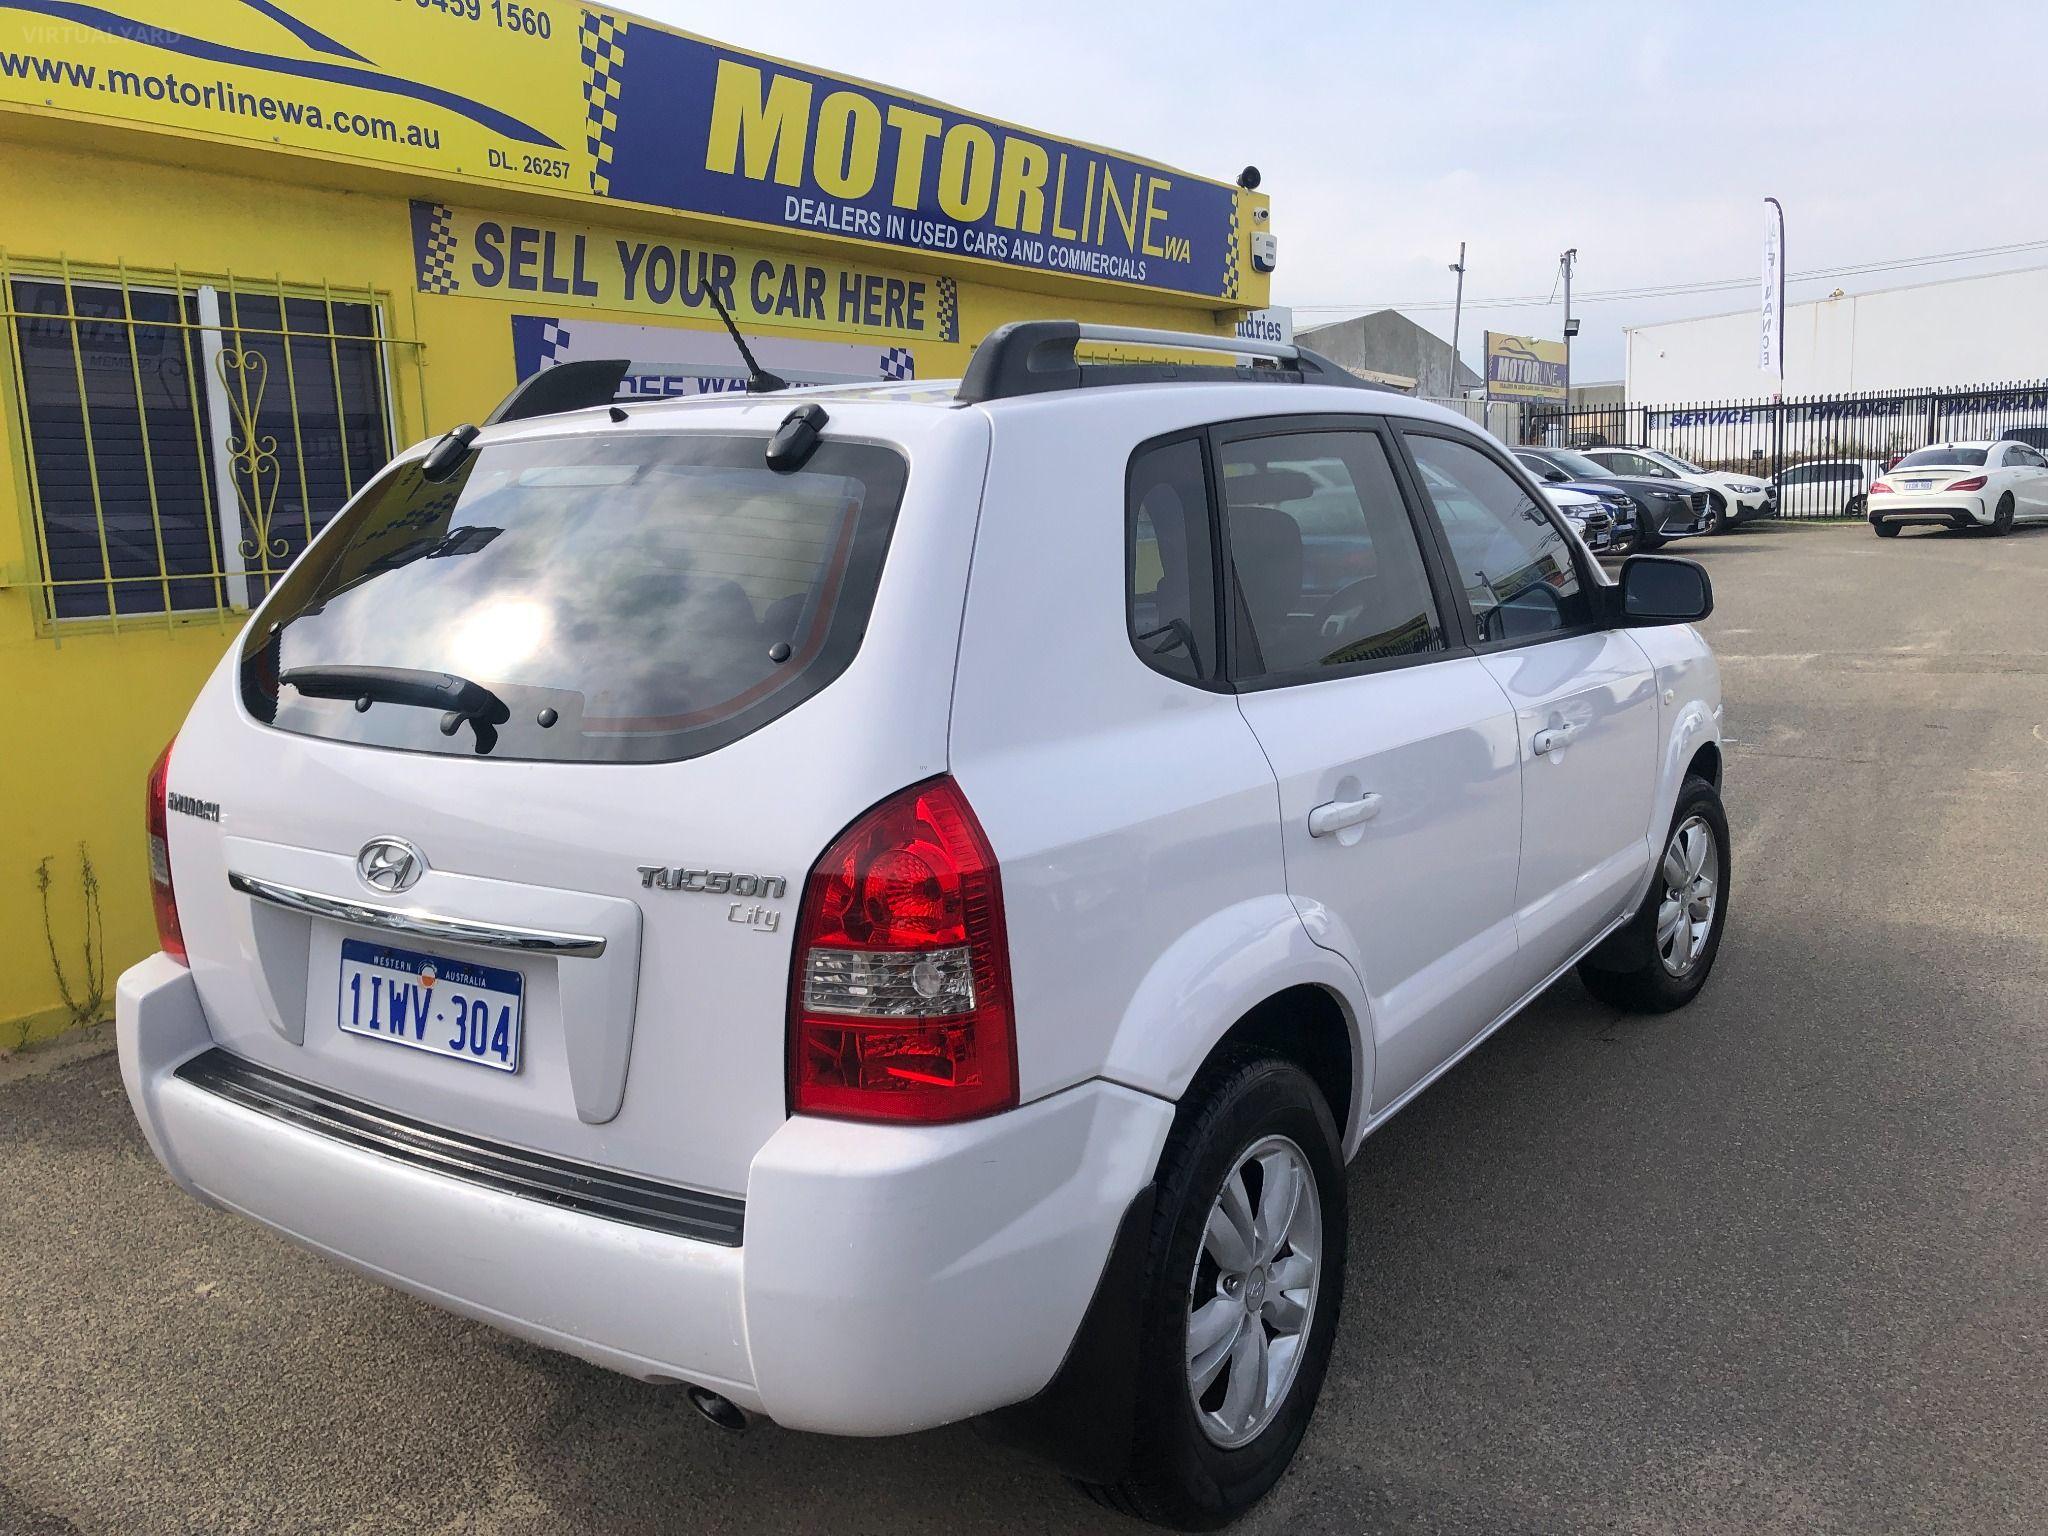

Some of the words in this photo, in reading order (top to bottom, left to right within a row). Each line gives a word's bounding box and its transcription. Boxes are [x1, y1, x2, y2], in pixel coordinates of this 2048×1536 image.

[491, 2, 551, 40] 1560
[0, 50, 441, 151] www.motorlinewa.com.au
[488, 148, 518, 172] DL.
[522, 155, 570, 180] 26257
[704, 58, 1172, 257] MOTORLINE
[1163, 235, 1191, 264] WA
[784, 195, 880, 236] DEALERS
[886, 217, 904, 240] IN
[910, 219, 959, 250] USED
[963, 228, 1008, 259] CARS
[1010, 239, 1044, 264] AND
[1047, 245, 1146, 281] COMMERCIALS
[472, 222, 599, 297] SELL
[616, 240, 737, 311] YOUR
[751, 259, 826, 320] CAR
[838, 271, 926, 331] HERE
[1497, 357, 1559, 386] MOTORLINE
[1669, 408, 1753, 428] SERVICE
[637, 864, 787, 898] TUCSON
[728, 902, 780, 932] City
[373, 955, 412, 972] WESTERN
[445, 970, 487, 988] AUSTRALIA
